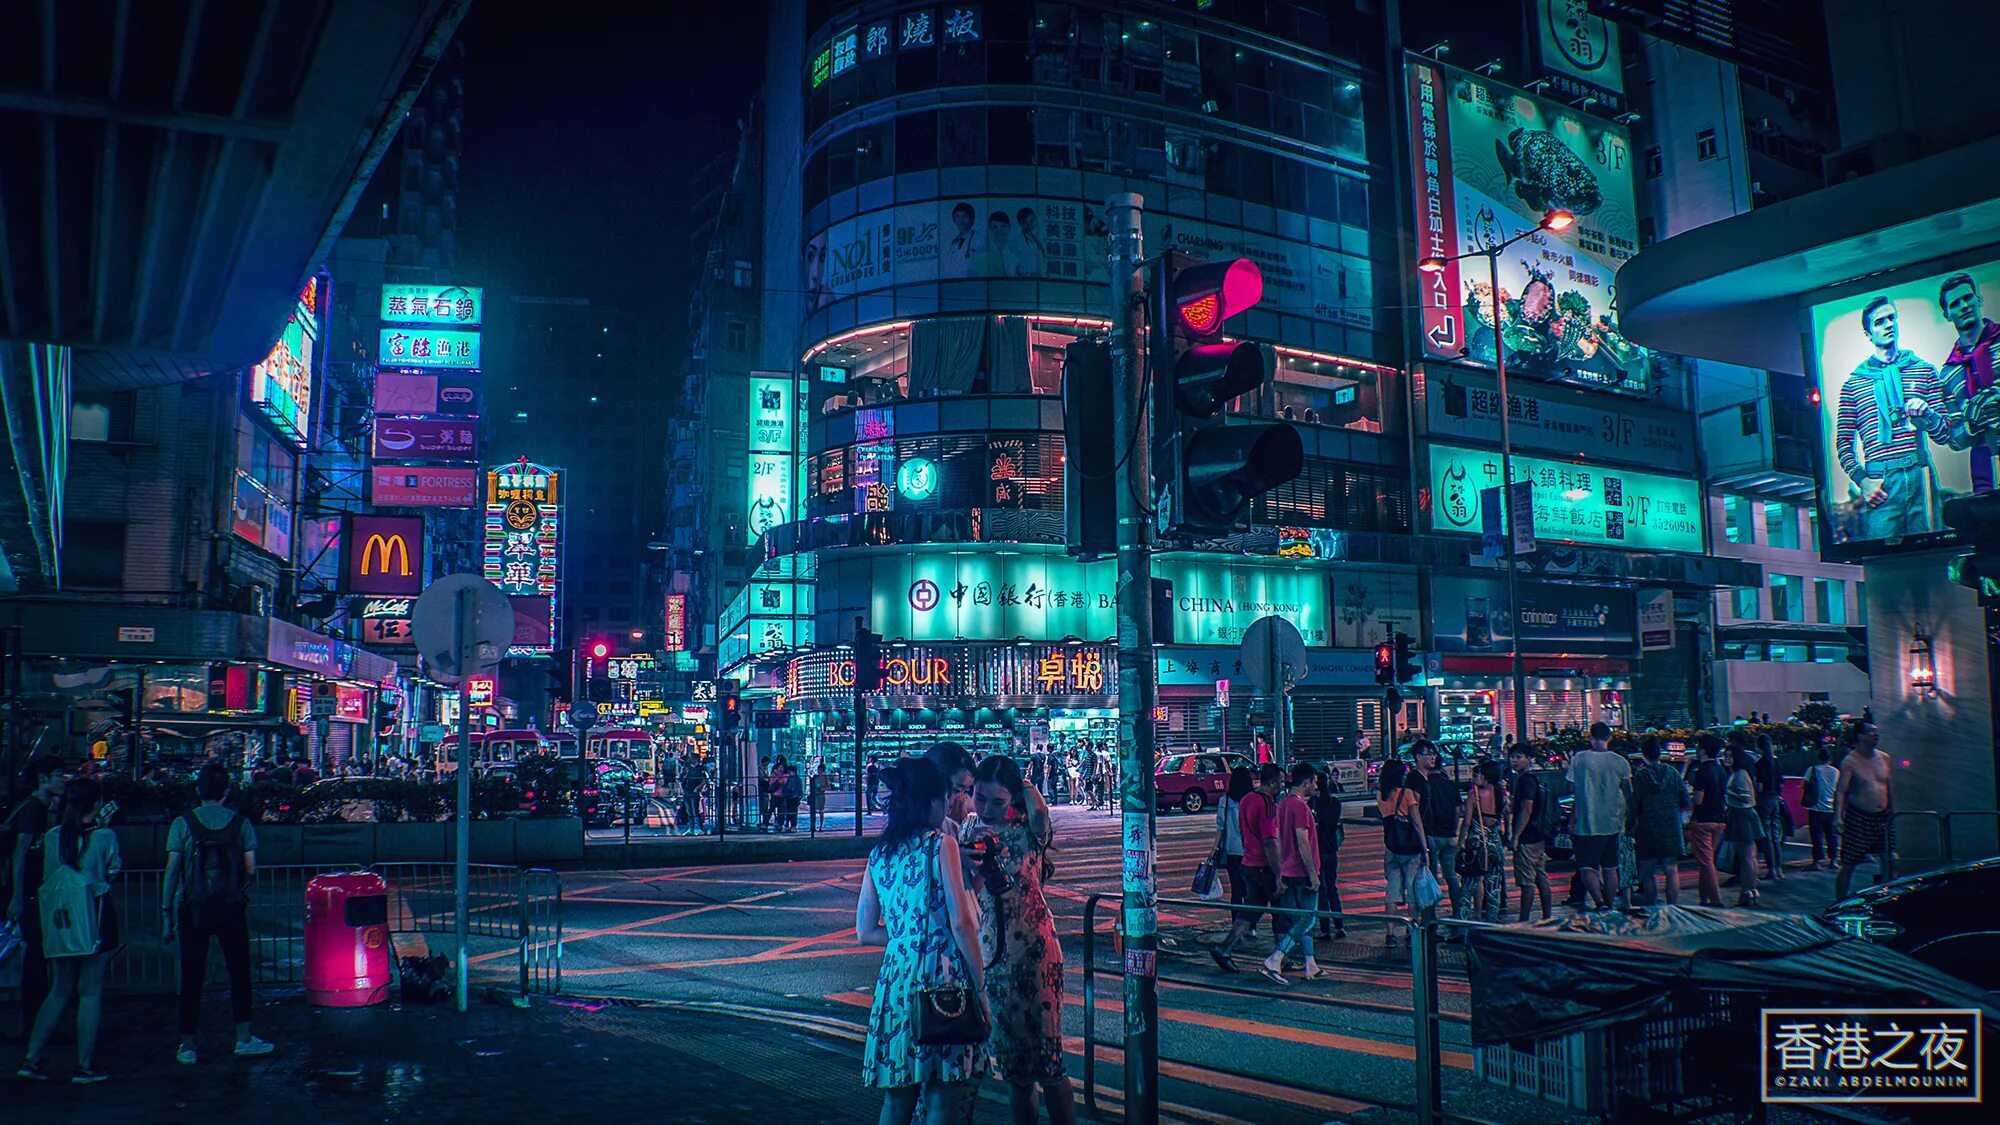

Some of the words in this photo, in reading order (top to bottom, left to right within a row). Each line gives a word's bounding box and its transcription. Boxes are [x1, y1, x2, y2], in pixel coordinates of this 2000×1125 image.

[1595, 139, 1626, 171] 3/F
[1418, 66, 1448, 309] 用電梯於轉角白加士入口
[1177, 232, 1224, 252] CHARMING
[388, 296, 474, 319] 蒸氣石鍋
[387, 333, 471, 357] 富臨漁港
[1472, 388, 1539, 421] 超級漁港
[758, 429, 782, 443] 3/F
[1602, 413, 1635, 448] 3/F
[754, 461, 775, 476] 2/F
[421, 476, 473, 488] FORTRESS
[1534, 504, 1603, 529] 海鮮飯店
[1627, 495, 1651, 528] 2/F
[1652, 516, 1697, 534] 35260918
[504, 532, 537, 591] 翠華
[1099, 593, 1118, 609] BA
[1179, 597, 1234, 613] CHINA
